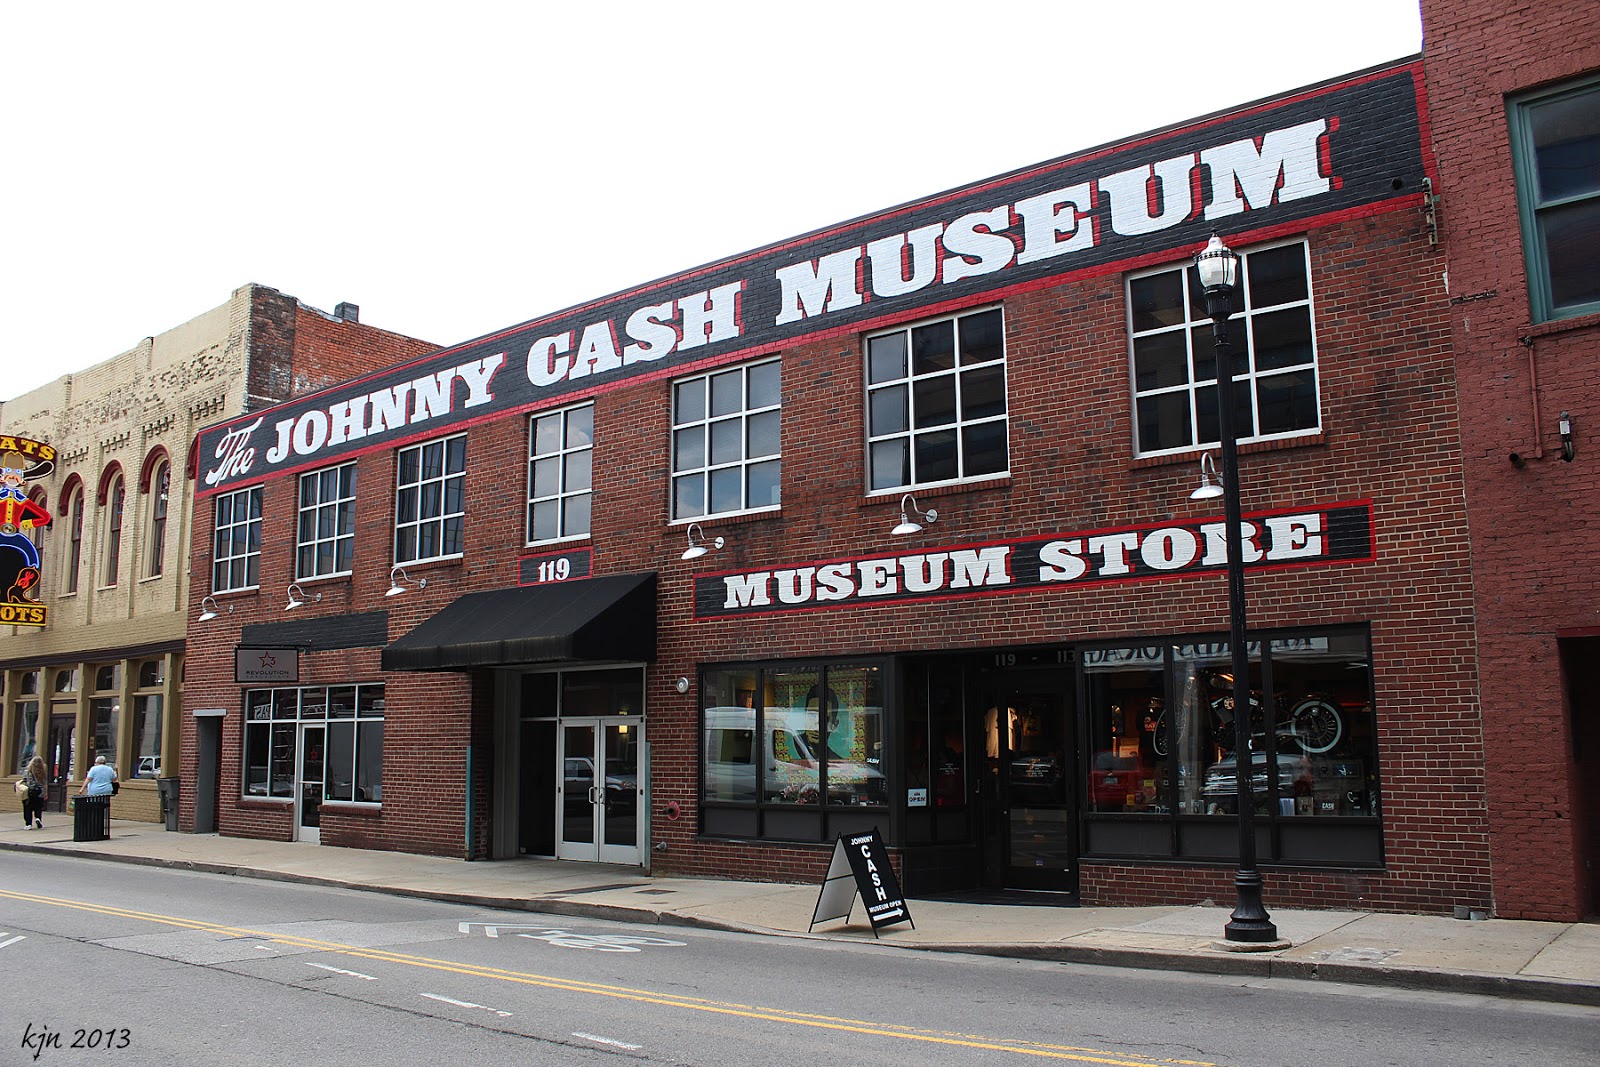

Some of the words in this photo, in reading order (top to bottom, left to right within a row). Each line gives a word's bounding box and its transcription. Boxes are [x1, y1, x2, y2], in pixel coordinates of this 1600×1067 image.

[205, 417, 264, 487] The
[266, 352, 504, 464] JOHNNY
[526, 280, 742, 387] CASH
[775, 117, 1332, 326] MUSEUM
[538, 557, 570, 582] 119
[723, 546, 1011, 609] MUSEUM
[1039, 513, 1322, 582] STORE
[994, 653, 1016, 667] 119
[851, 835, 873, 846] JOHNNY
[861, 844, 887, 901] CASH
[869, 902, 890, 913] MUSEUM
[889, 900, 902, 910] OPEN
